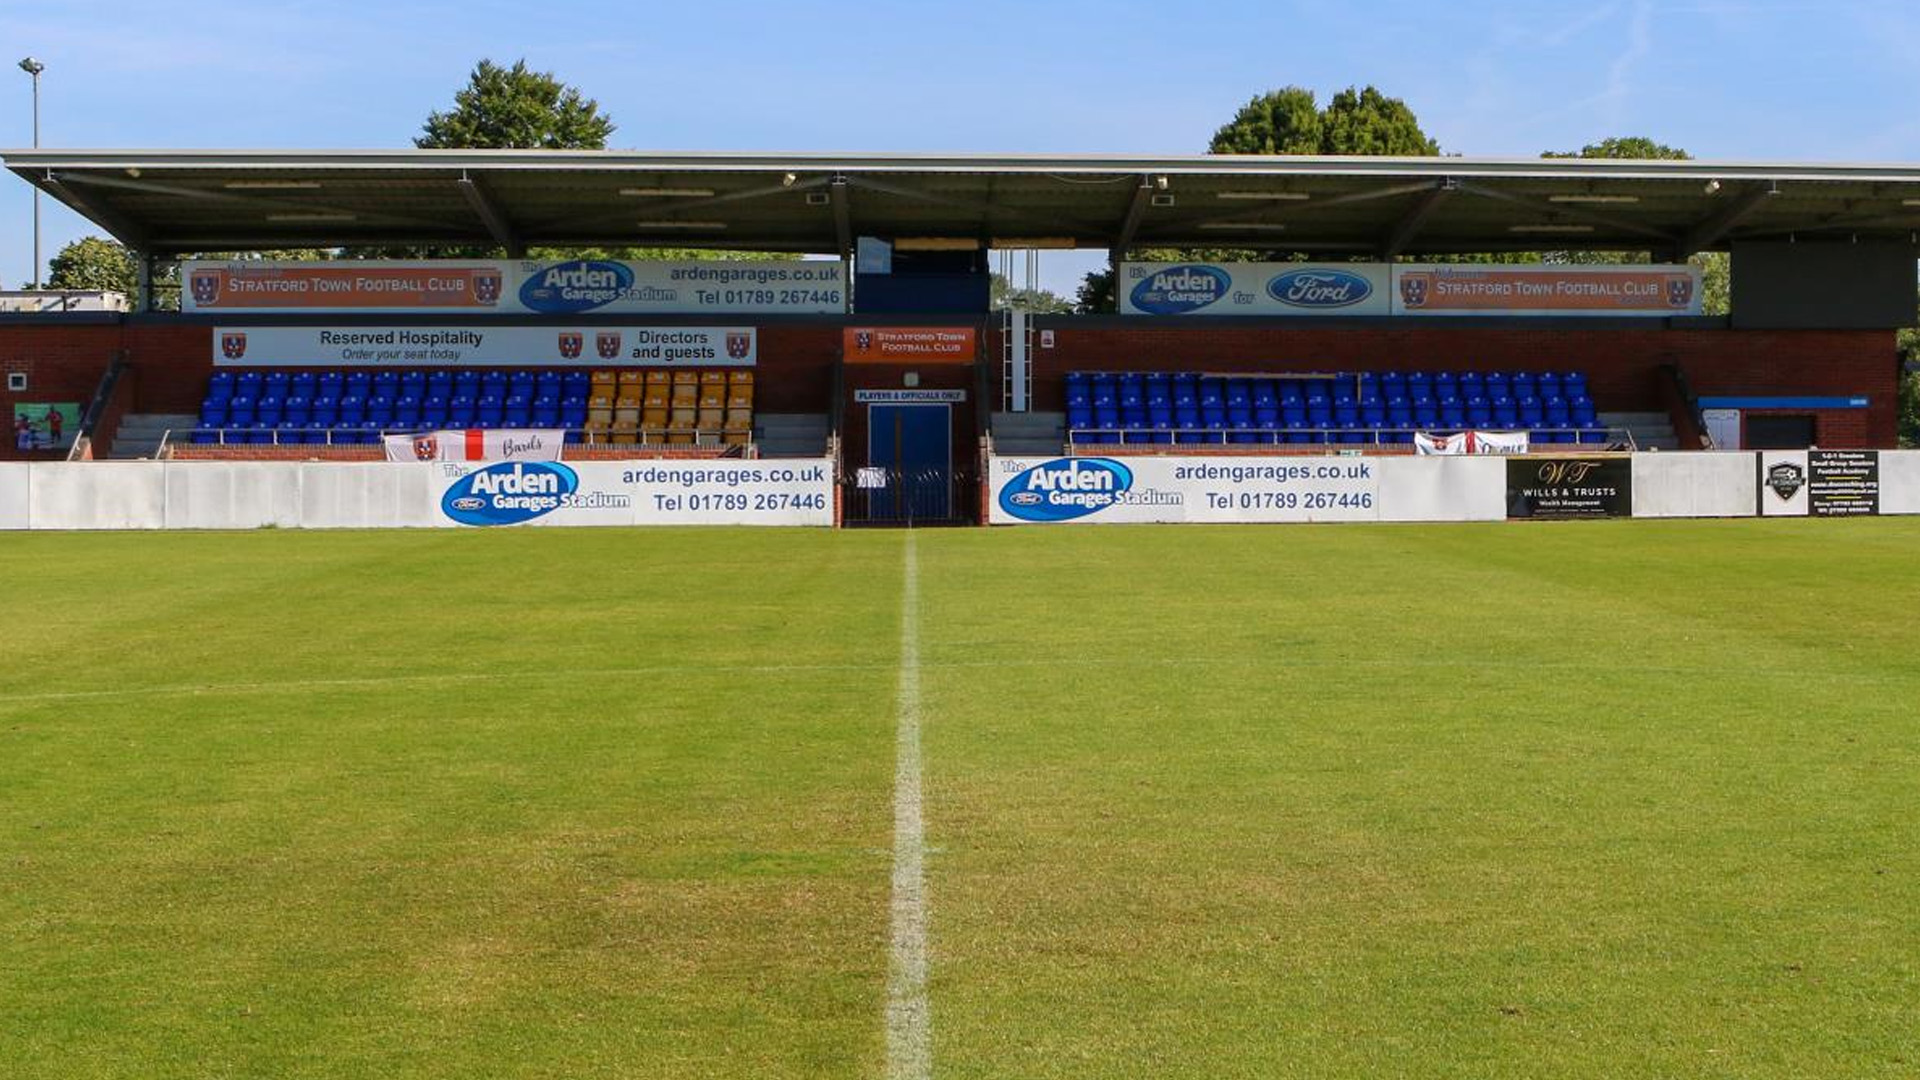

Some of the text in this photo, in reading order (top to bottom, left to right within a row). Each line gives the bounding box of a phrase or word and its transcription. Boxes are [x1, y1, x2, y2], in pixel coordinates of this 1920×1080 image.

[544, 262, 617, 287] Arden
[670, 266, 839, 284] ardengarages.co.uk
[1152, 268, 1216, 290] Arden
[229, 277, 465, 292] STRATFORD TOWN FOOTBALL CLUB
[1288, 274, 1351, 301] Ford
[1436, 281, 1658, 295] STRATFORD TOWN FOOTBALL CLUB
[561, 287, 616, 303] Garages
[617, 286, 677, 301] Stadium
[696, 290, 839, 304] Tel 01789 267446
[1168, 291, 1215, 304] Garages
[320, 330, 483, 348] Reserved Hospitality
[639, 330, 708, 344] Directors
[877, 332, 966, 341] STRATFORD TOWN
[342, 349, 461, 362] Order your seat today
[632, 345, 715, 362] and guests
[882, 343, 961, 352] FOOTBALL CLUB
[1000, 460, 1027, 473] The
[1028, 459, 1113, 491] Arden
[1175, 463, 1370, 483] ardengarages.co.uk
[471, 463, 559, 494] Arden
[622, 466, 824, 487] ardengarages.co.uk
[492, 494, 558, 511] Garages
[559, 491, 631, 509] Stadium
[1049, 491, 1113, 509] Garages
[1114, 488, 1184, 505] Stadium
[1206, 492, 1372, 509] Tel 01789 267446
[1523, 487, 1616, 498] WILLS & TRUSTS
[654, 493, 825, 511] Tel 01789 267446
